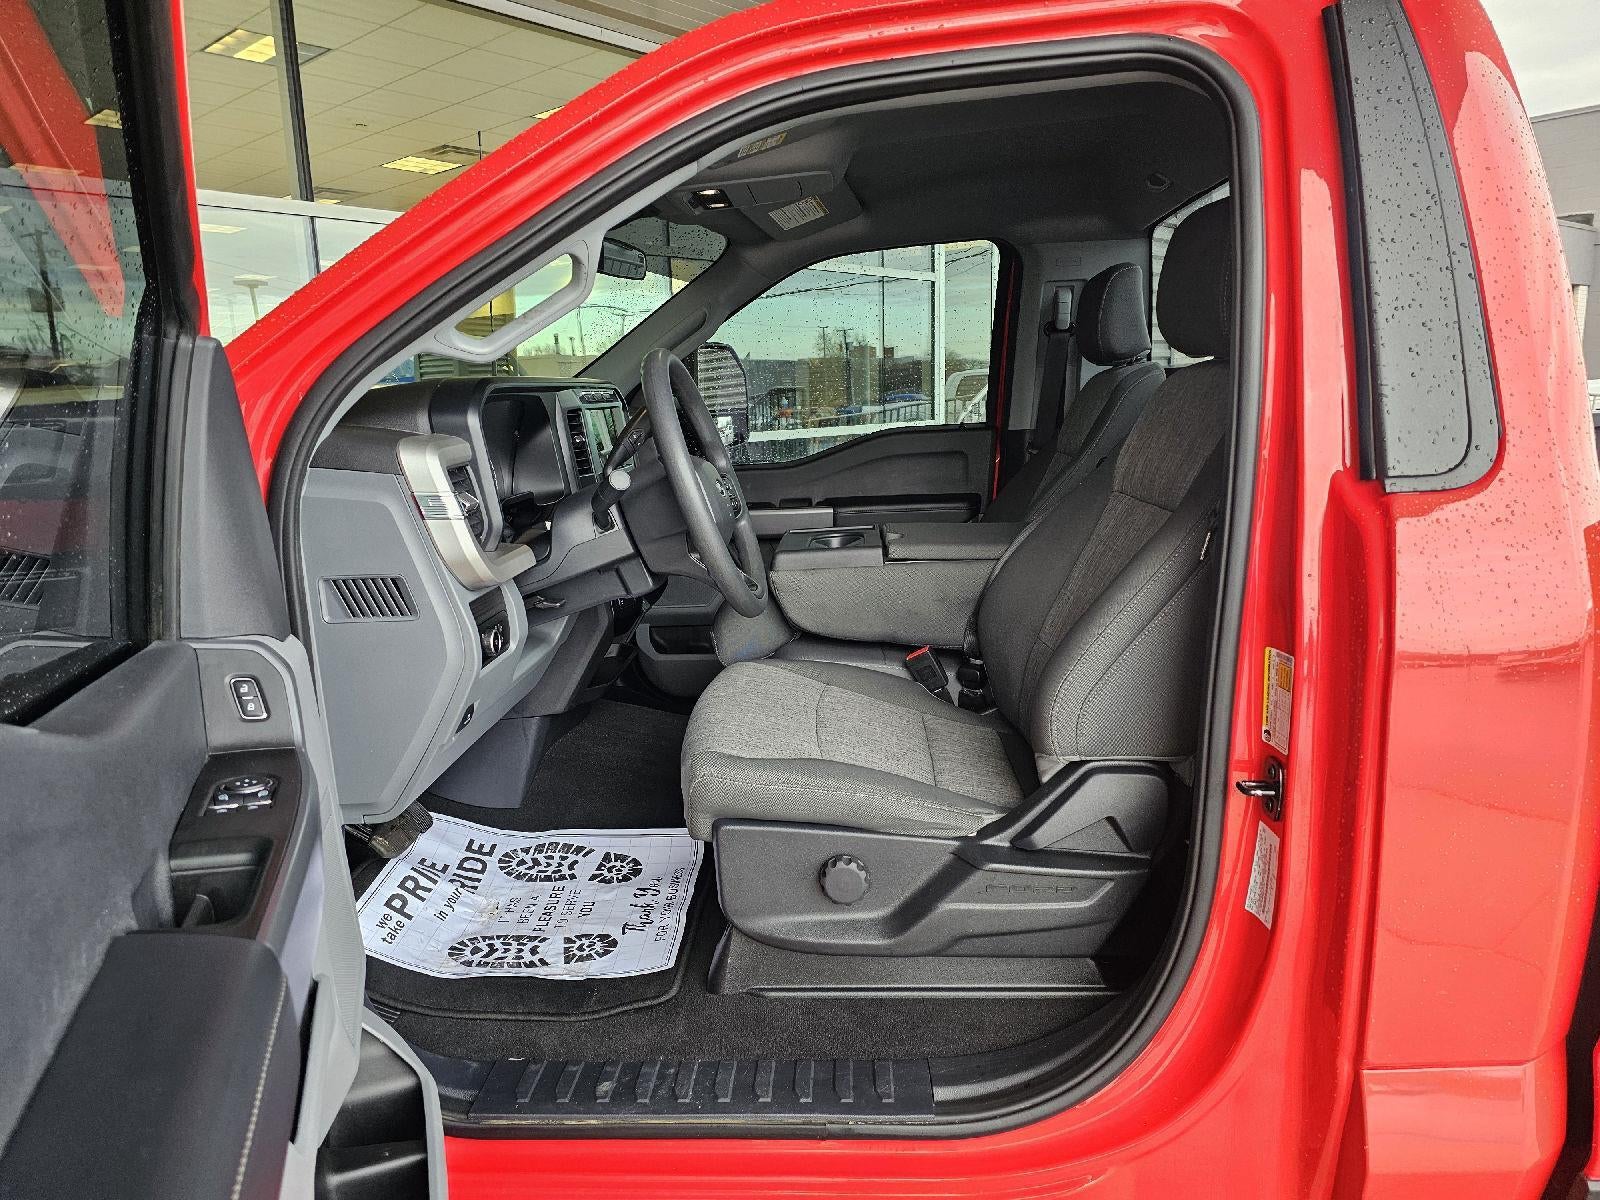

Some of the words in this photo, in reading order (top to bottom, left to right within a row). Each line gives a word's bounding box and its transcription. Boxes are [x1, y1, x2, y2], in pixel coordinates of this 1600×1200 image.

[383, 857, 451, 922] PRIE
[665, 867, 686, 901] BUSINESS
[433, 910, 449, 922] in
[444, 887, 462, 912] your
[532, 885, 566, 933] PLEASURE
[560, 889, 582, 916] SERVE
[577, 901, 596, 919] YOU
[659, 901, 675, 924] YOUR
[375, 913, 393, 930] we
[381, 919, 406, 945] take
[553, 918, 569, 929] TO
[654, 923, 670, 942] FOR
